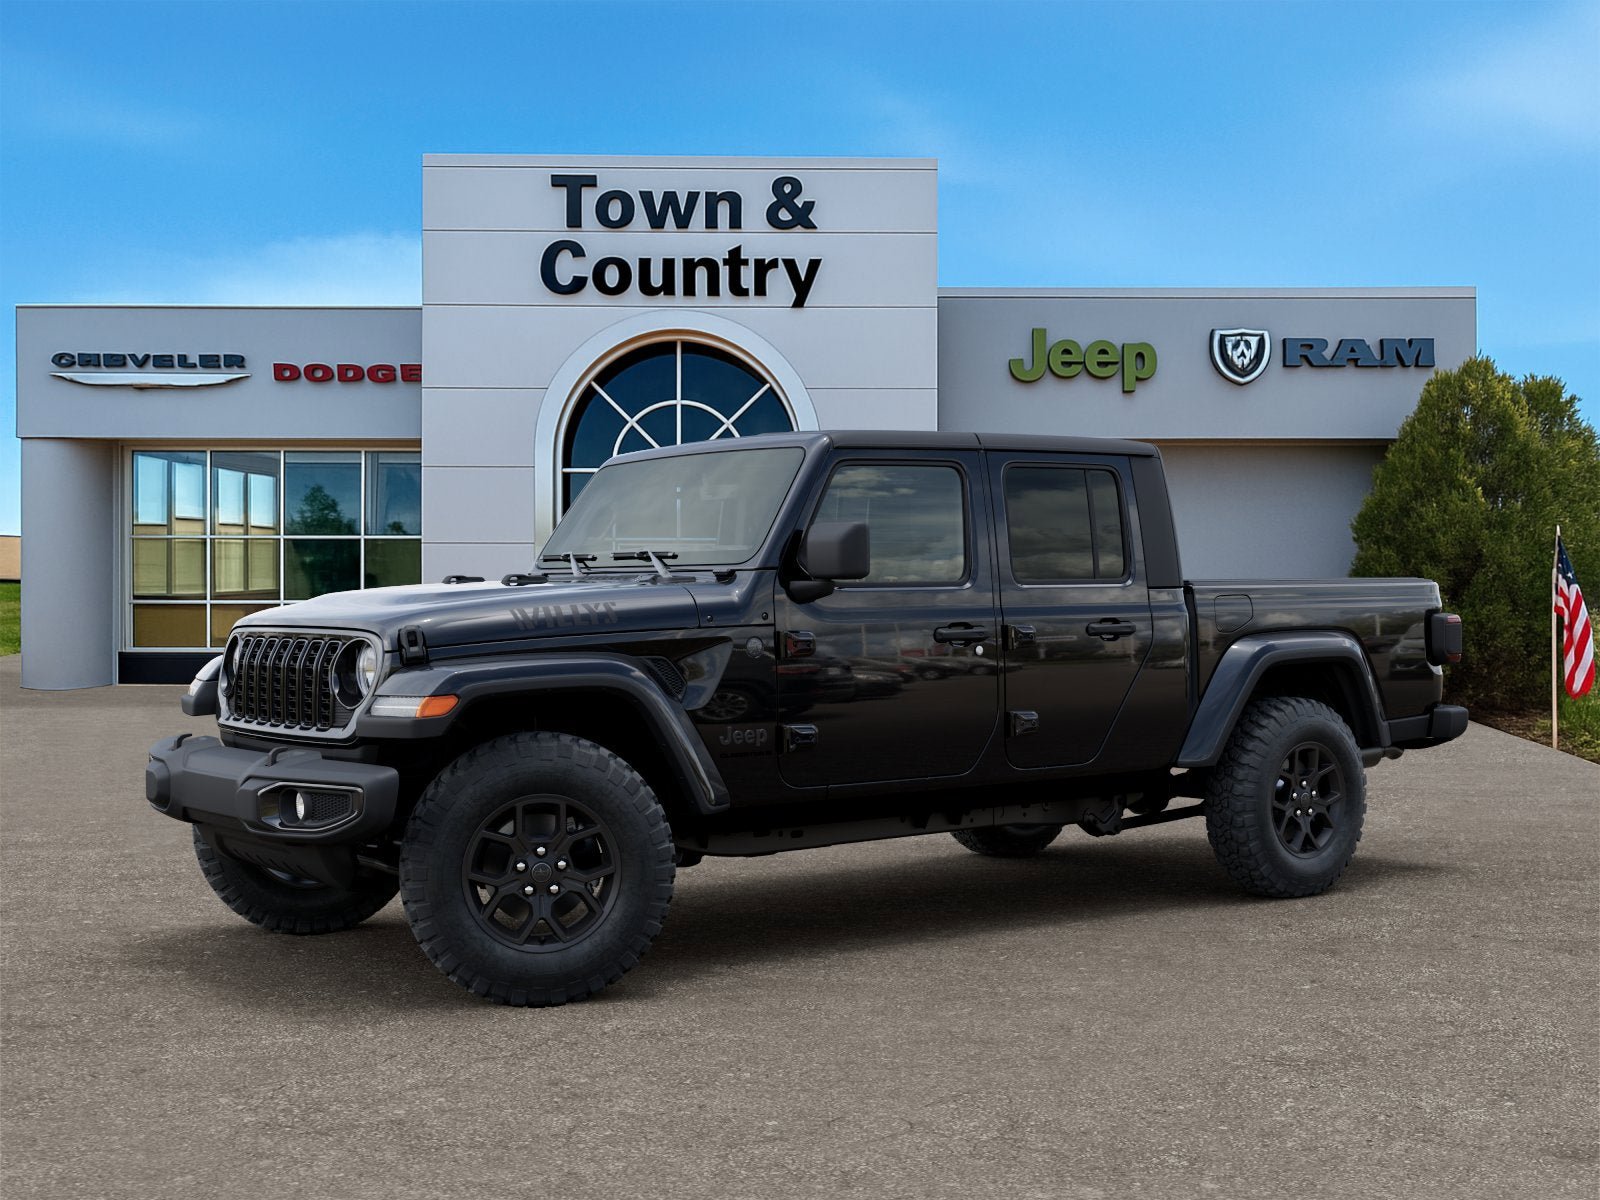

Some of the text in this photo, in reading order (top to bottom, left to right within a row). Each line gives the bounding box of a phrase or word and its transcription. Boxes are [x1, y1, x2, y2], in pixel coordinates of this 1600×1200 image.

[550, 174, 818, 230] Town &
[540, 239, 822, 308] Country
[1009, 327, 1157, 393] Jeep
[1282, 337, 1435, 368] RAM
[273, 362, 422, 383] DODGE
[509, 601, 618, 631] WILLYS
[719, 725, 768, 747] Jeep
